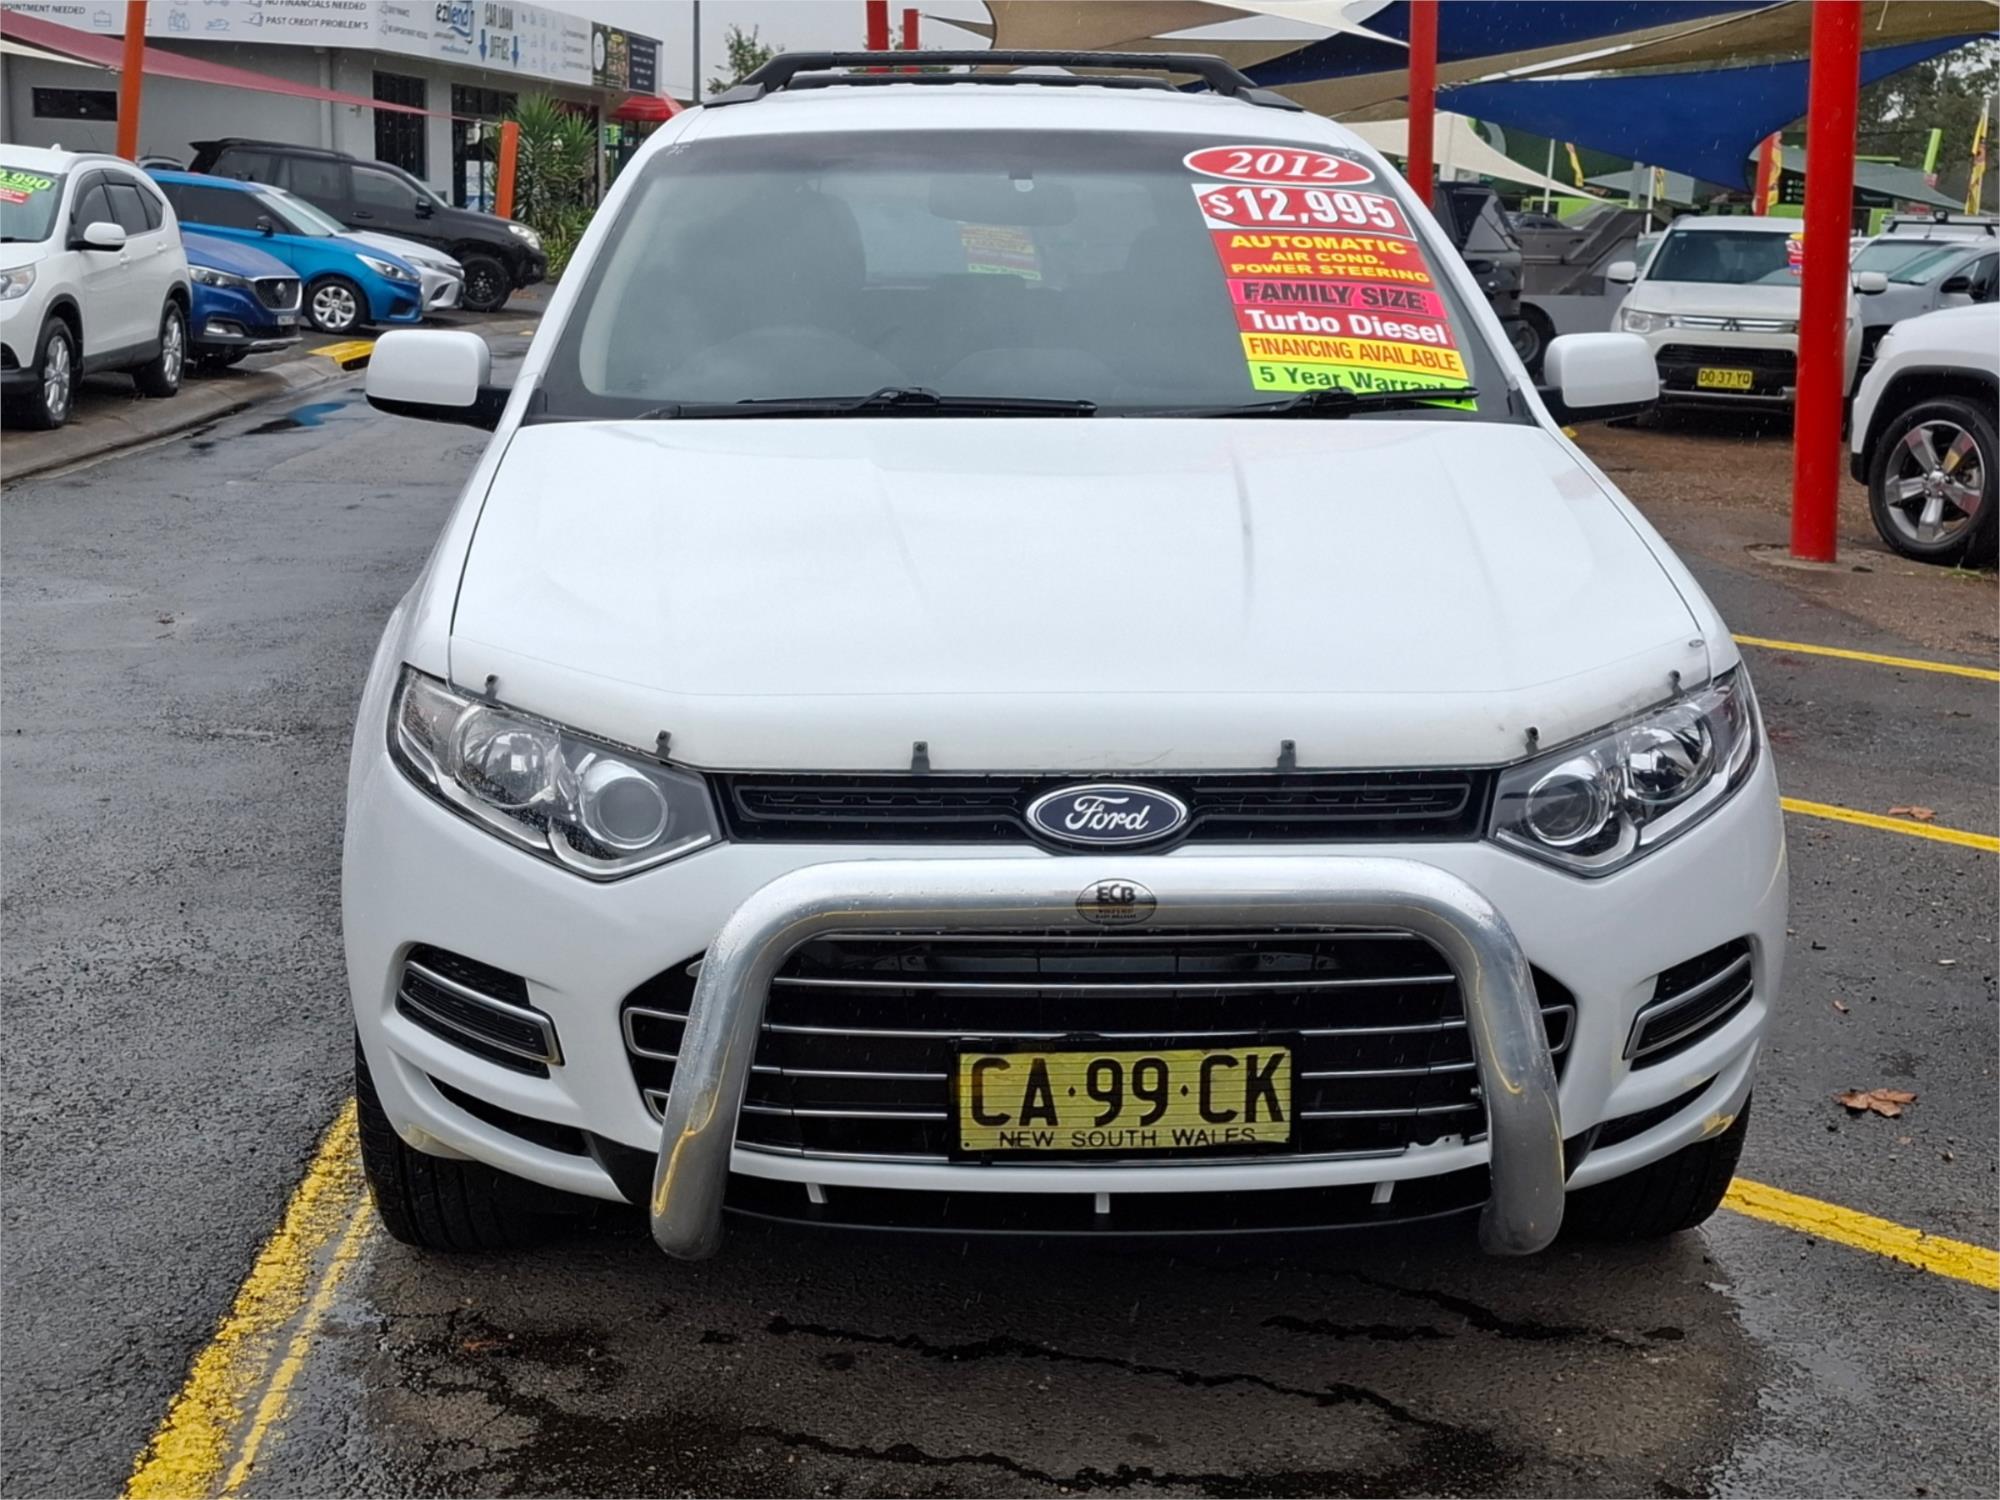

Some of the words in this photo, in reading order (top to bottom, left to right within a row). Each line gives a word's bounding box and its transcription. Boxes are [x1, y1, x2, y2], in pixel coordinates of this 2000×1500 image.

[52, 6, 86, 15] NEEDED
[280, 0, 331, 9] FINANCIALS
[332, 1, 367, 10] NEEDED
[266, 16, 287, 25] PAST
[288, 17, 318, 26] CREDIT
[320, 19, 369, 29] PROBLEM'S
[1223, 151, 1340, 179] 2012
[1208, 187, 1396, 229] $12,995
[1231, 234, 1408, 255] AUTOMATIC
[1271, 251, 1310, 262] AIR
[1315, 252, 1385, 265] COND.
[1231, 264, 1315, 275] POWER
[1319, 264, 1431, 283] STEERING
[1243, 281, 1352, 304] FAMILY
[1361, 286, 1427, 311] SIZE
[1245, 309, 1340, 333] Turbo
[1348, 313, 1448, 345] Diesel
[1249, 337, 1354, 360] FINANCING
[1360, 343, 1460, 372] AVAILABLE
[1259, 366, 1276, 383] 5
[1284, 366, 1341, 388] Year
[1064, 795, 1151, 830] Ford
[1096, 884, 1136, 902] ECB
[999, 1130, 1055, 1148] NEW
[1071, 1129, 1157, 1147] SOUTH
[1171, 1127, 1257, 1145] WALES
